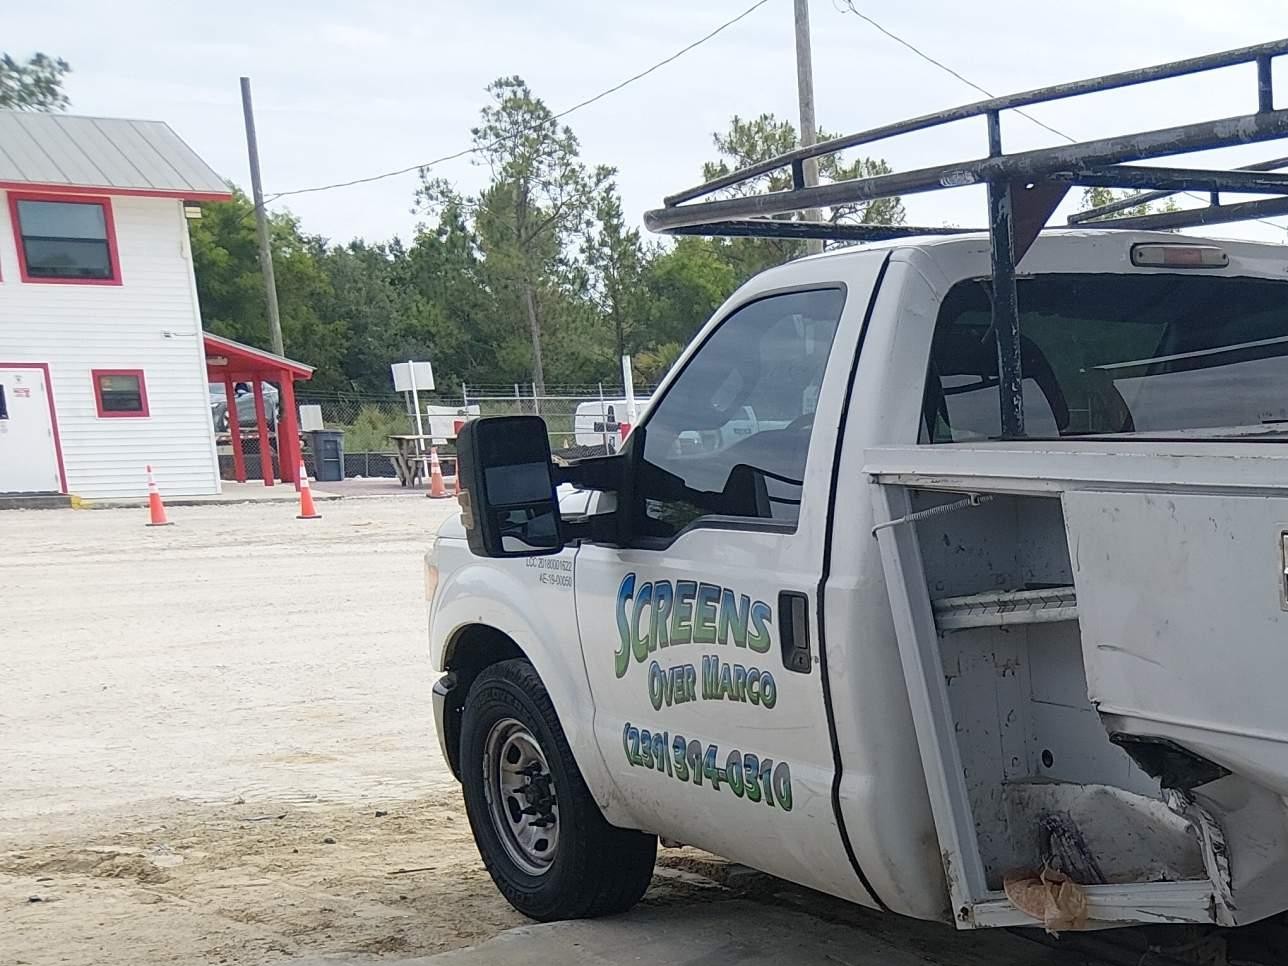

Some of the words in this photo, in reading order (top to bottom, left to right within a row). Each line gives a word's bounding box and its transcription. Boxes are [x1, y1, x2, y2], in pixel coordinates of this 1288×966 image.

[614, 572, 773, 680] SCREENS
[648, 660, 697, 711] OVER
[702, 656, 777, 710] MARCO
